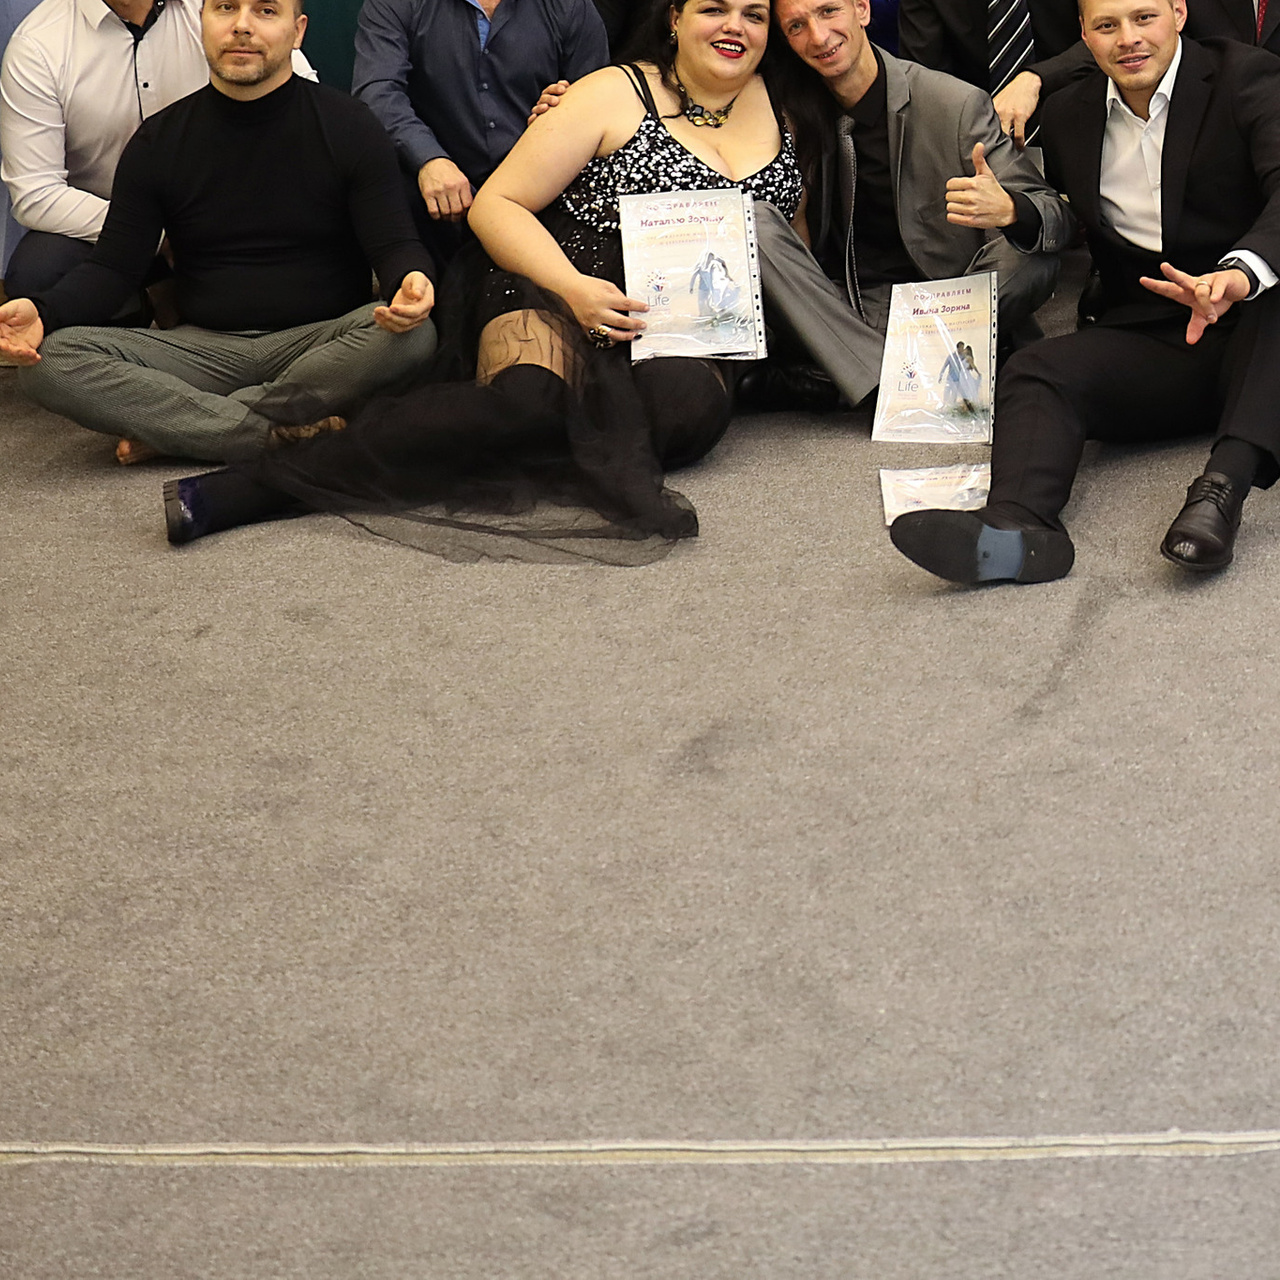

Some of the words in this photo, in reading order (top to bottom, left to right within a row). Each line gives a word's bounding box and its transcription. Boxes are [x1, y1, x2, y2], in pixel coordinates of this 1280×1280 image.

[640, 218, 685, 227] Наталью
[647, 295, 670, 308] Life
[941, 304, 971, 314] Зорина
[898, 380, 919, 392] Life
